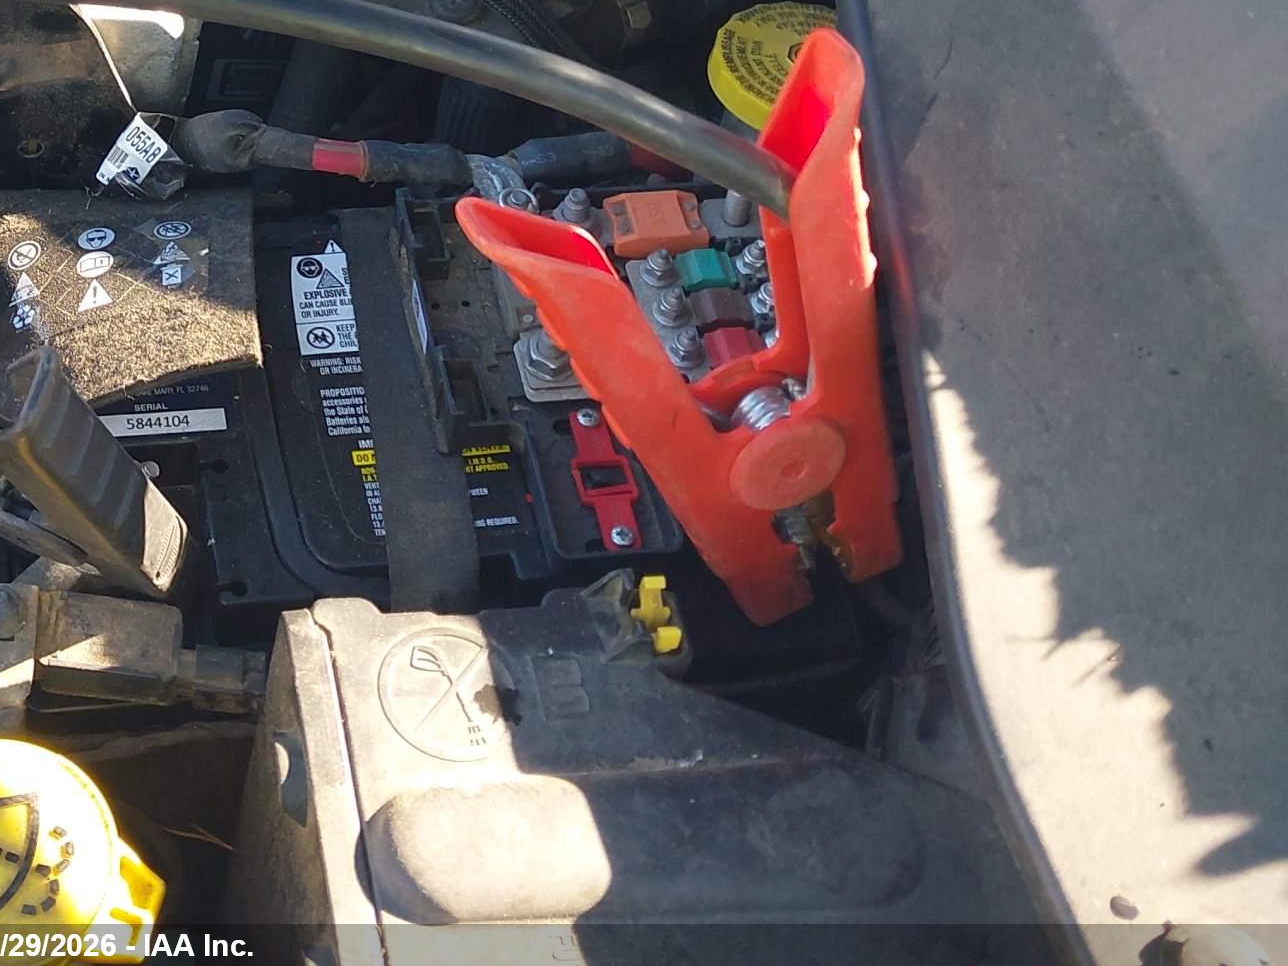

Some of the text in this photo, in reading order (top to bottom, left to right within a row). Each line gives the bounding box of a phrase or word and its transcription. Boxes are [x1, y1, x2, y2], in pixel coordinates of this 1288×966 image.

[125, 126, 162, 164] 055AB
[304, 287, 347, 300] EXPLOSIVE
[299, 299, 314, 310] CAN
[315, 298, 338, 309] CAUSE
[301, 309, 312, 319] OR
[336, 323, 355, 333] KEEP
[338, 332, 353, 341] THE
[309, 357, 344, 368] WARNING:
[322, 396, 363, 407] accessories
[134, 402, 169, 413] SERIAL
[324, 404, 364, 417] the State of
[126, 414, 191, 430] 5844104
[326, 415, 358, 427] Batteries
[328, 426, 362, 436] California
[356, 454, 370, 463] DO
